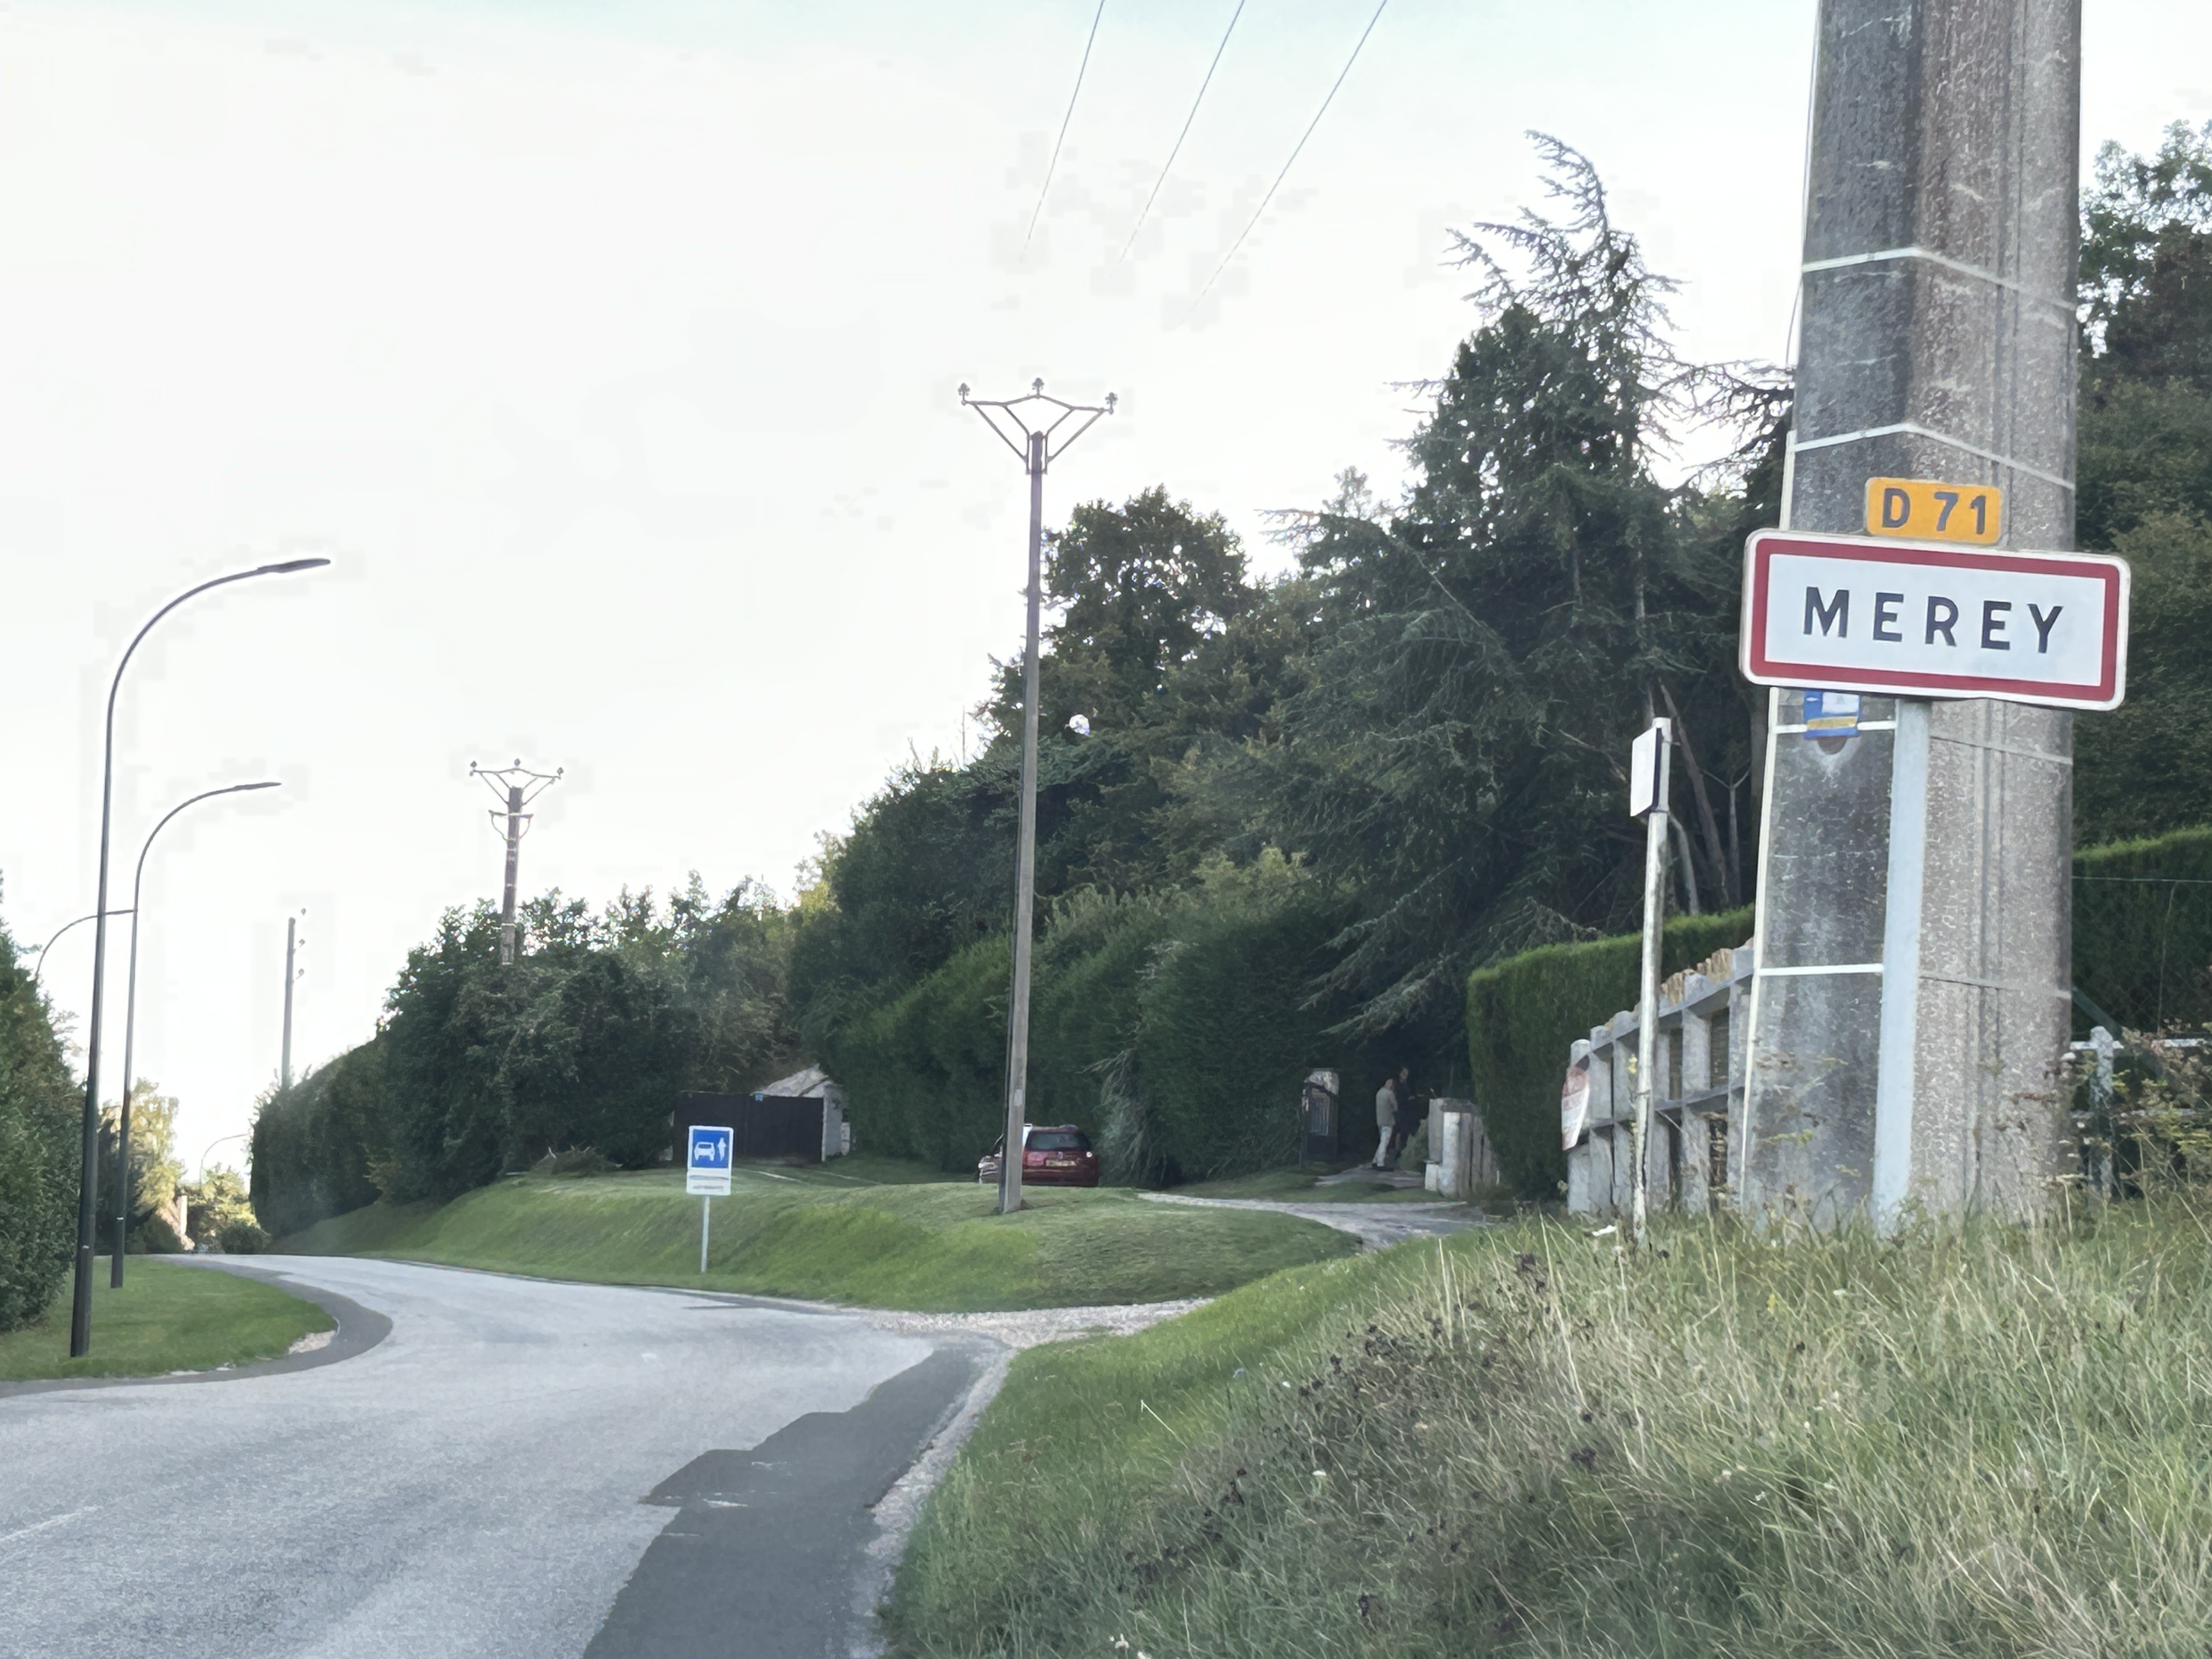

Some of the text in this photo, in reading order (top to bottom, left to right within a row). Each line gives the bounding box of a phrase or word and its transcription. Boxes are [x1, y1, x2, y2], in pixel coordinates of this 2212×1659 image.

[1882, 488, 1987, 535] D 71
[1803, 586, 2064, 653] MEREY
